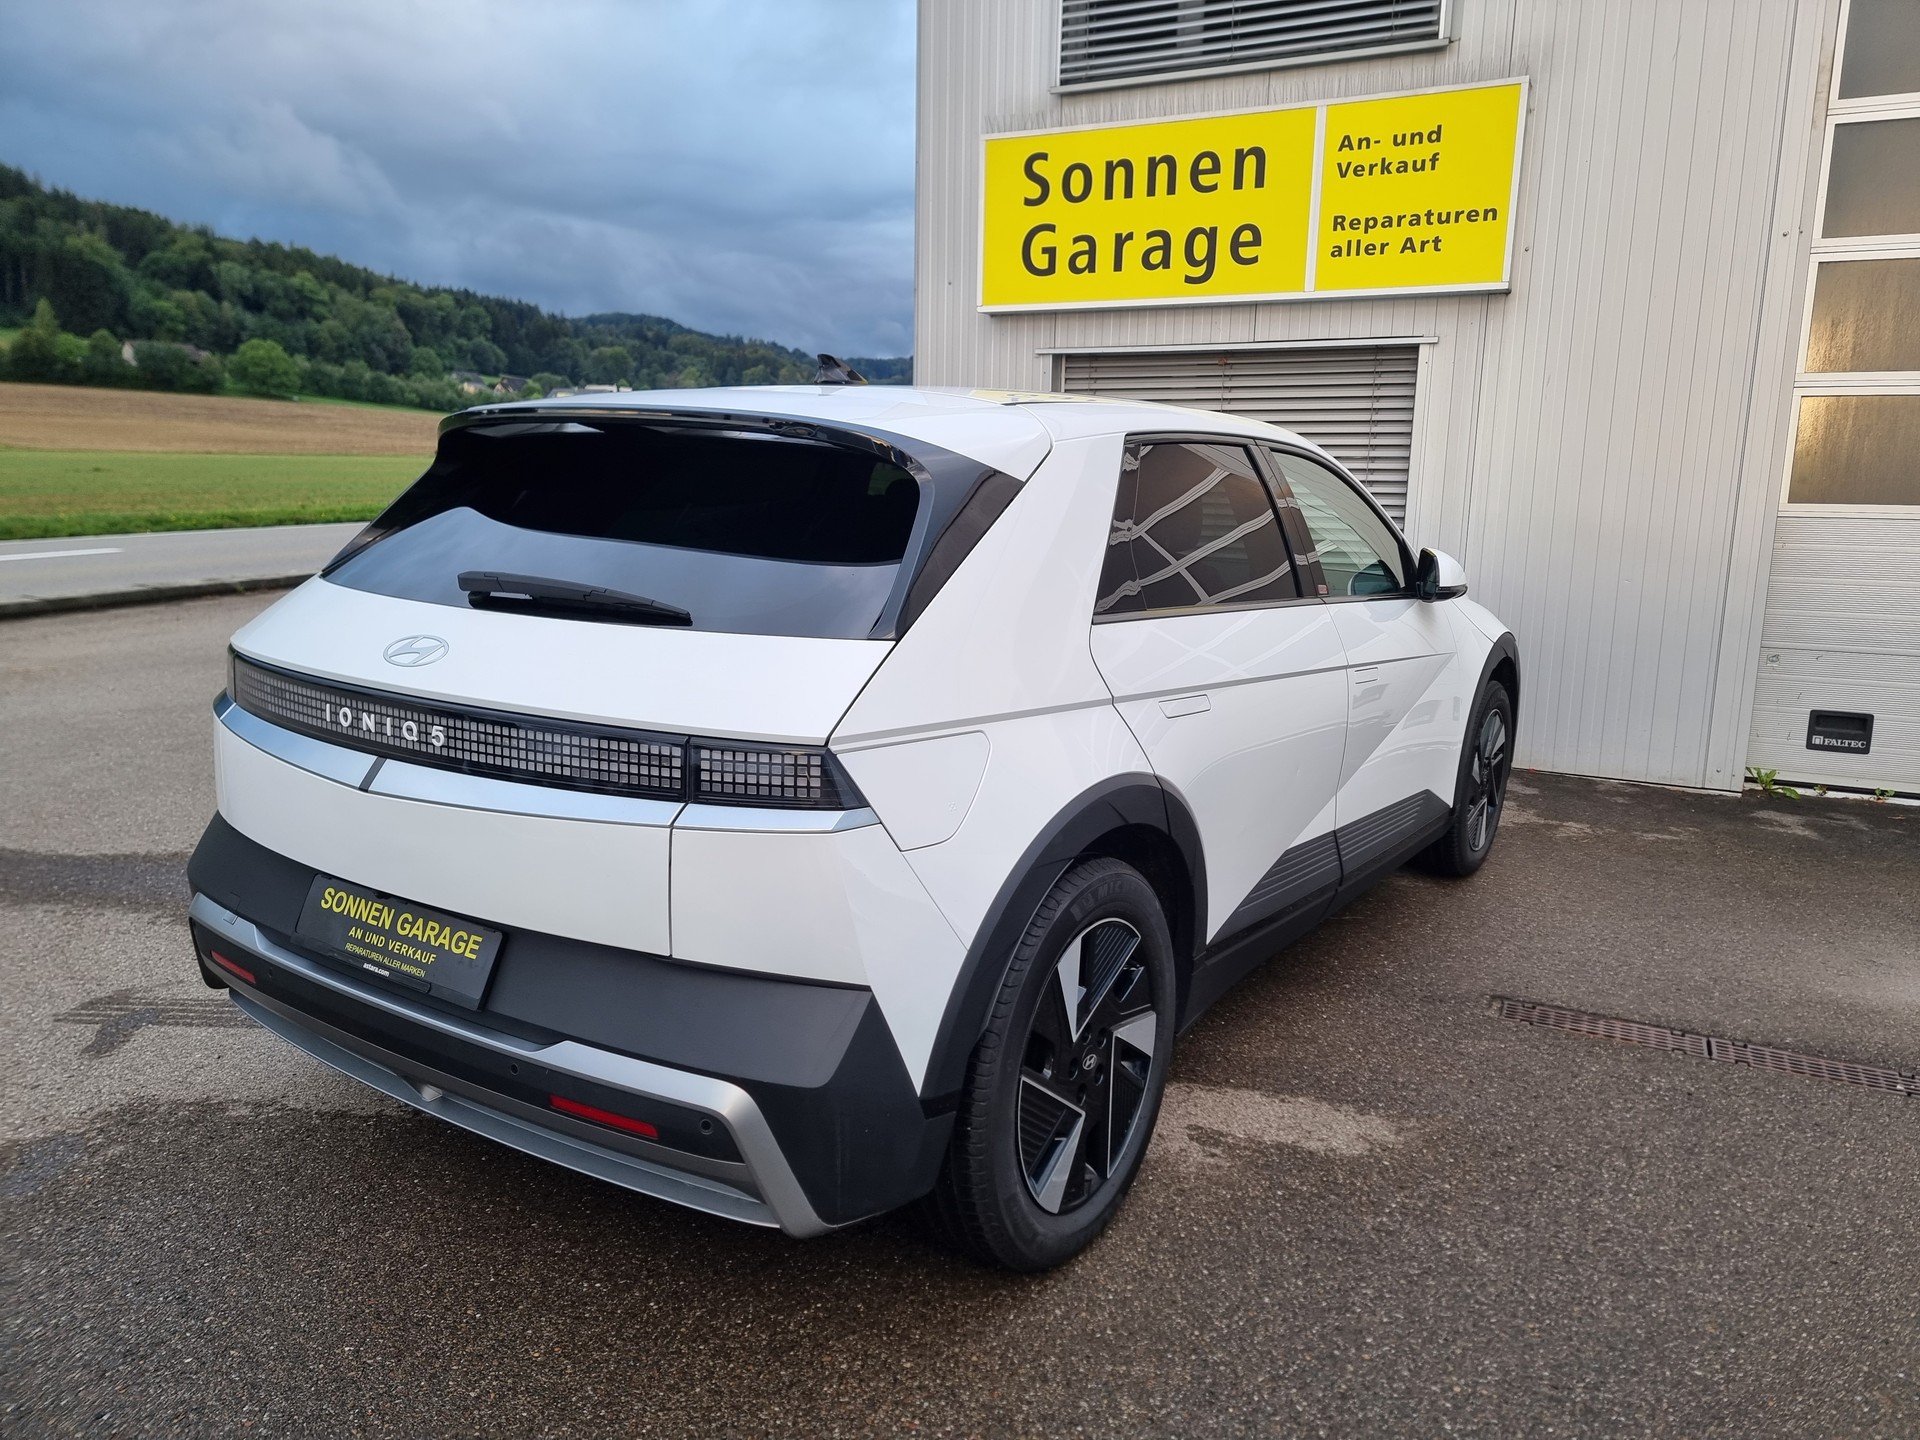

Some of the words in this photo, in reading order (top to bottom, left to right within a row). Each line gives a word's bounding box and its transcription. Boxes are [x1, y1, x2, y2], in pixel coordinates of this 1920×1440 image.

[1338, 132, 1381, 152] An-
[1392, 125, 1443, 148] und
[1022, 143, 1267, 207] Sonnen
[1336, 151, 1441, 179] Verkauf
[1332, 204, 1498, 235] Reparaturen
[1021, 220, 1263, 285] Garage
[1330, 237, 1390, 259] aller
[1399, 234, 1443, 254] Art
[1823, 738, 1866, 748] FALTEC
[320, 887, 395, 930] SONNEN
[396, 912, 483, 960] GARAGE
[344, 942, 384, 963] REPARATUREN
[382, 956, 401, 969] ALLER
[400, 961, 426, 978] MARKEN
[348, 926, 364, 941] AN
[364, 931, 385, 948] UND
[388, 940, 437, 965] VERKAUF
[363, 962, 390, 977] astara.com
